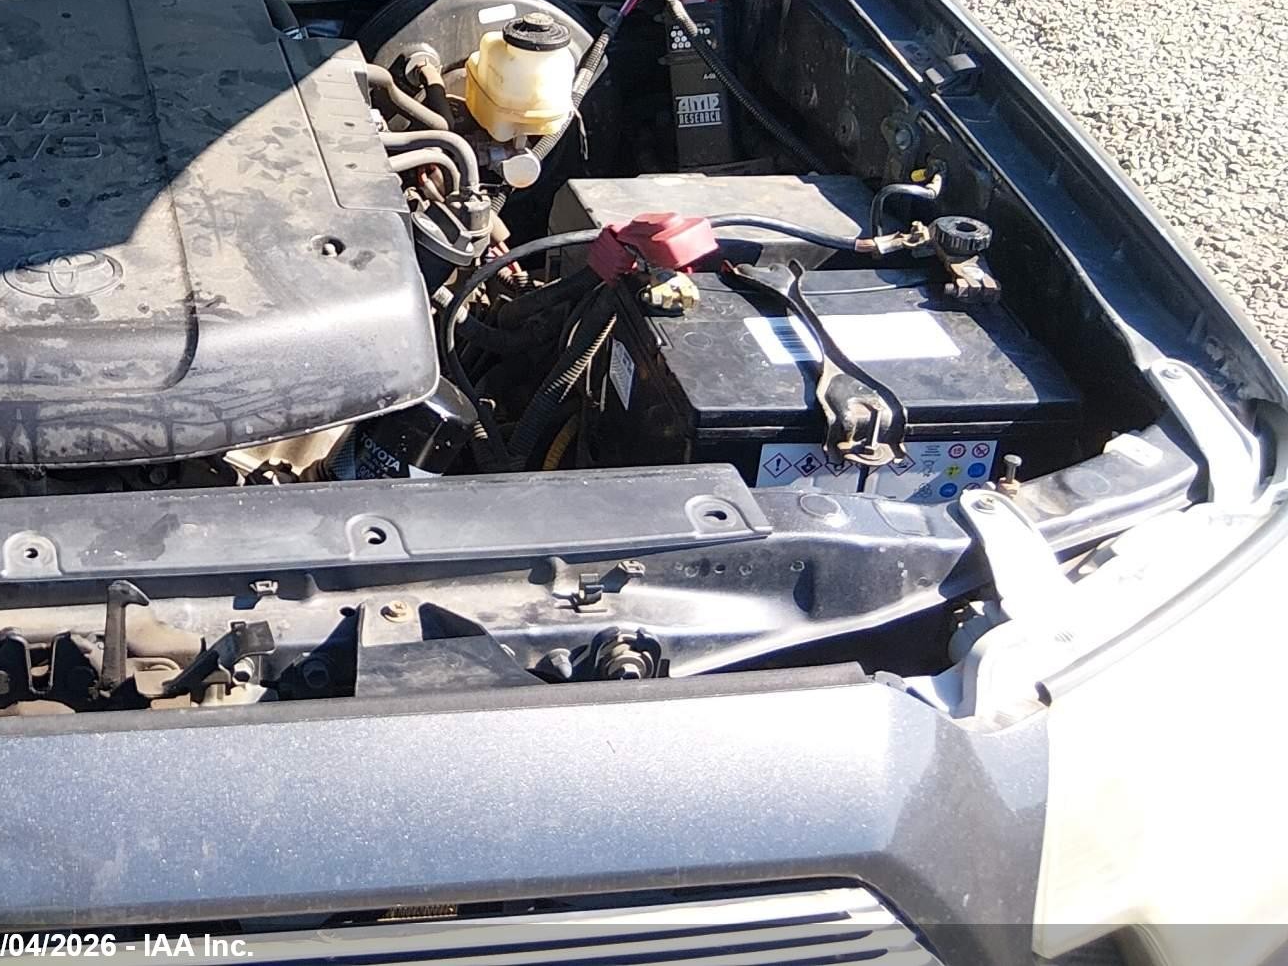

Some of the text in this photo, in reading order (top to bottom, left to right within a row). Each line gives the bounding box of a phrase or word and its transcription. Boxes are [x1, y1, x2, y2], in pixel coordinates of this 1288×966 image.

[678, 96, 720, 113] AMP
[679, 110, 721, 124] RESEARCH
[360, 432, 401, 472] TOYOTA
